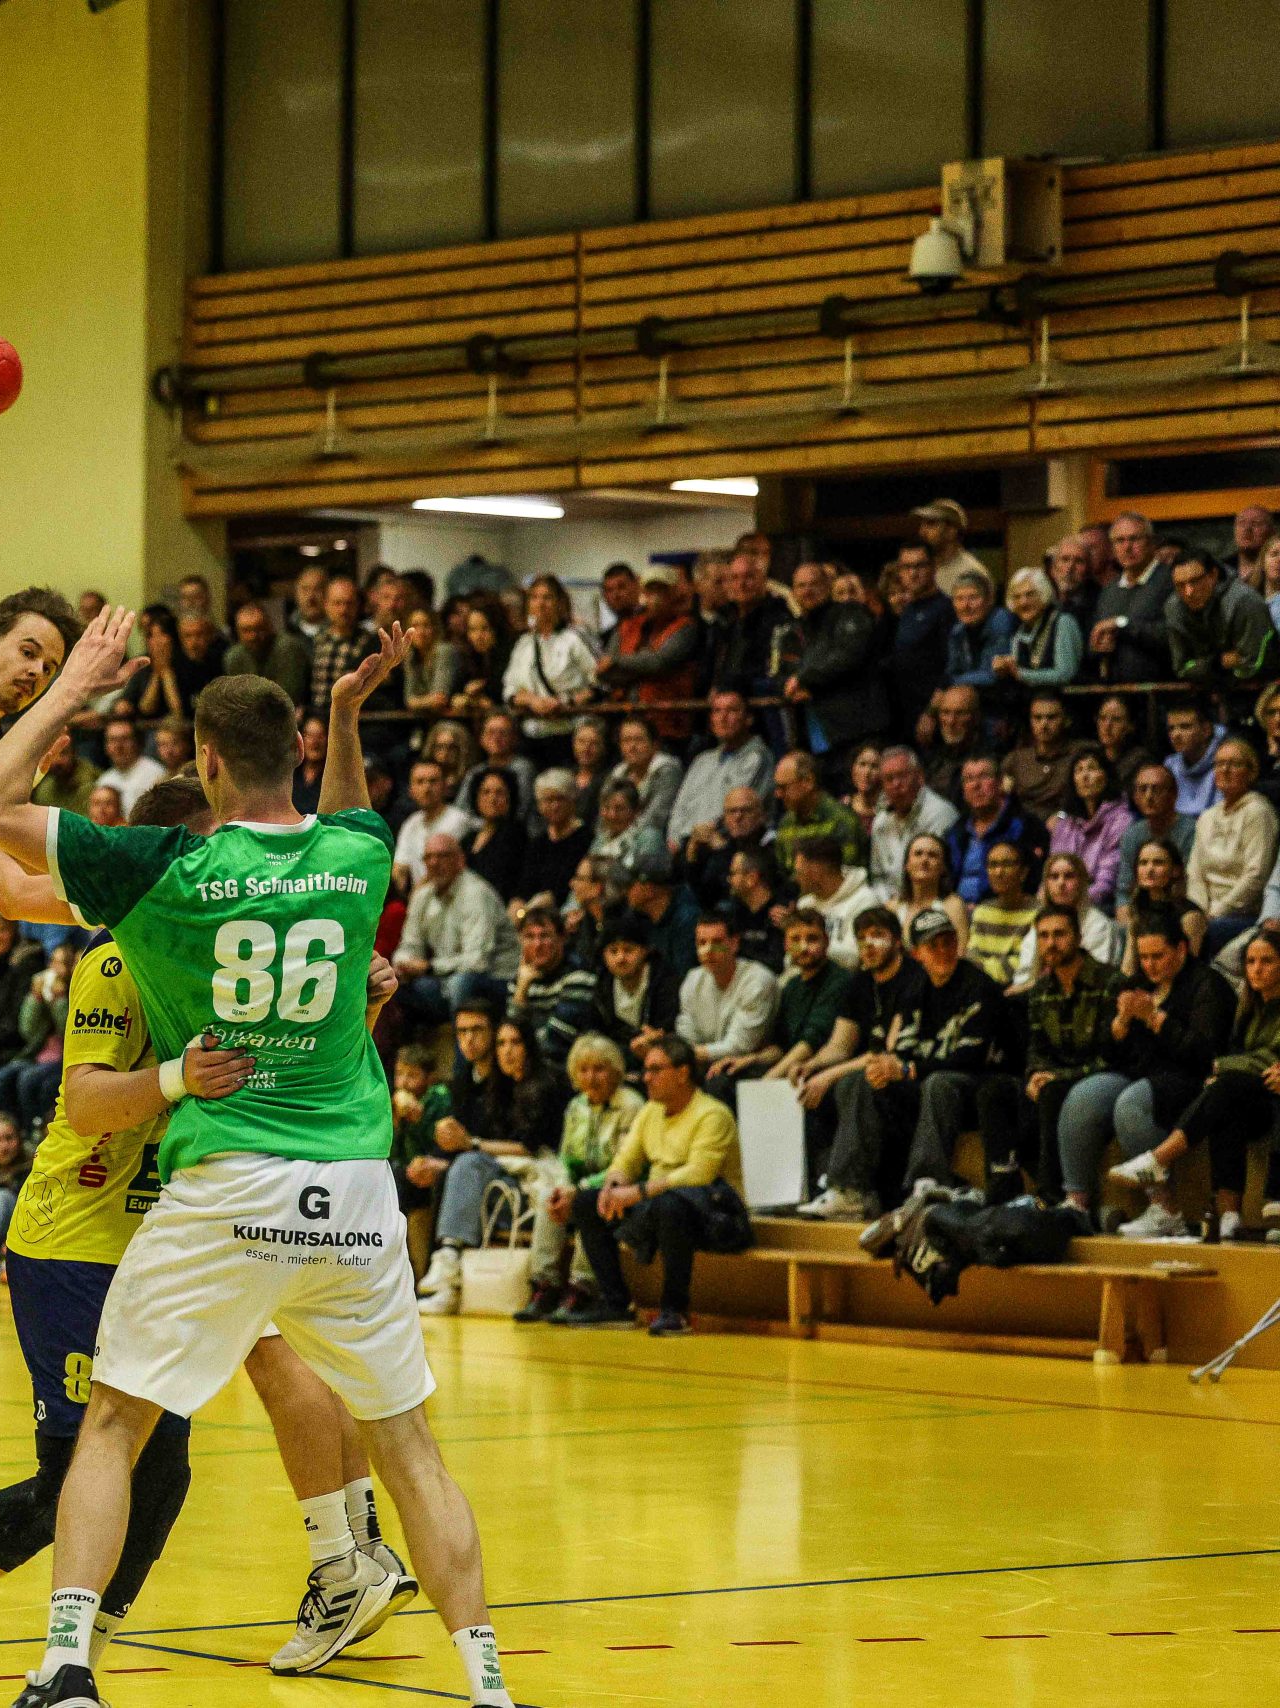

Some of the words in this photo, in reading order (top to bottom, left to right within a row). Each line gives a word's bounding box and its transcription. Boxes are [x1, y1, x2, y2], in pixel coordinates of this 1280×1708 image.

[196, 879, 238, 902] TSG
[245, 872, 368, 897] Schnaitheim
[212, 919, 345, 1023] 86
[298, 1185, 331, 1220] G
[233, 1224, 383, 1248] KULTURSALONG
[245, 1248, 278, 1263] essen
[287, 1253, 327, 1265] mieten
[336, 1253, 372, 1266] kultur
